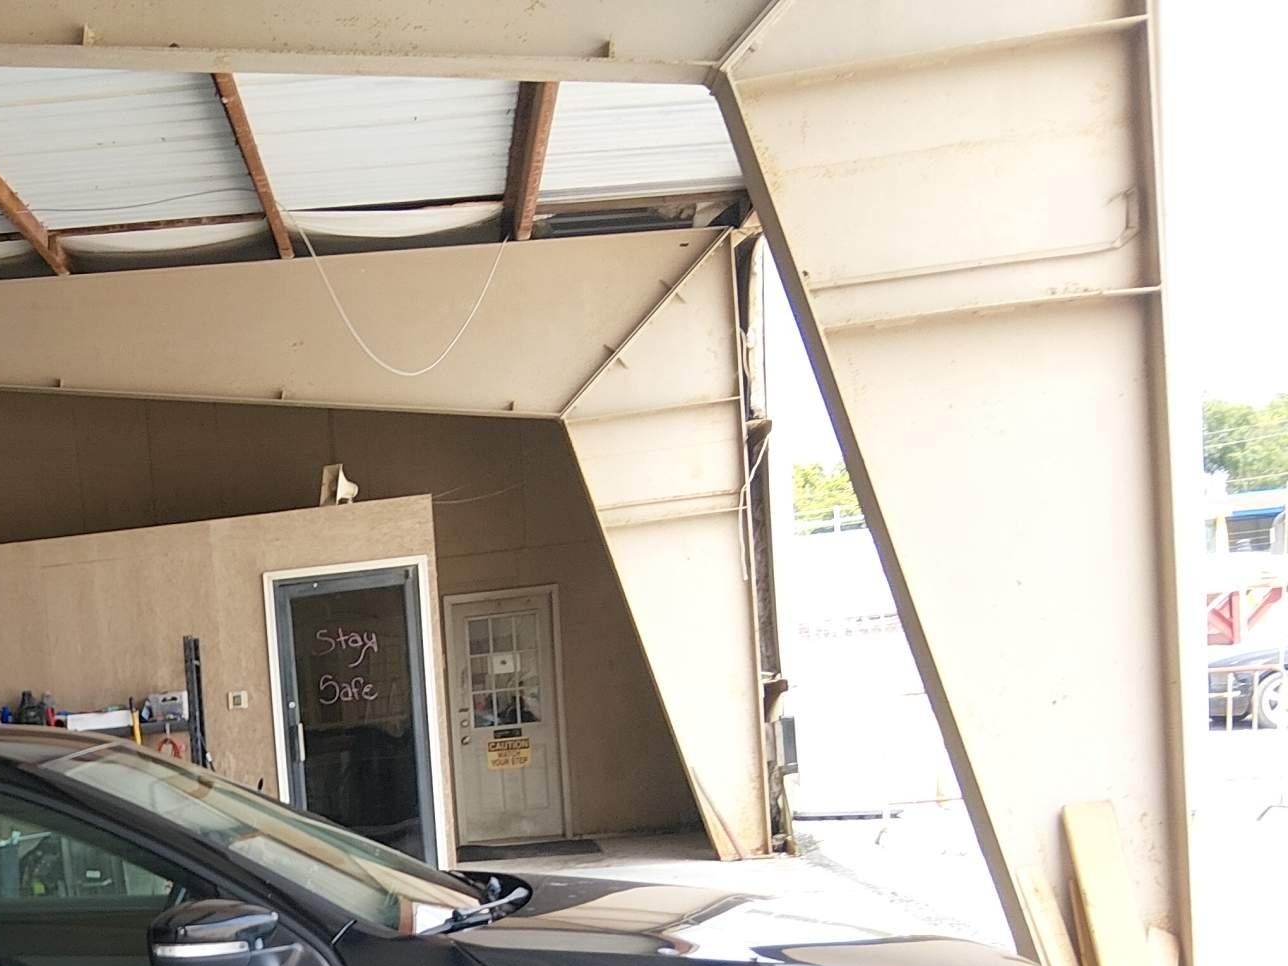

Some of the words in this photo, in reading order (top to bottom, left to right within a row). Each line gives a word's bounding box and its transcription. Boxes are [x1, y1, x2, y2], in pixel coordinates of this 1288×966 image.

[314, 627, 378, 668] Stay
[319, 674, 378, 704] Safe
[489, 739, 529, 751] CAUTION
